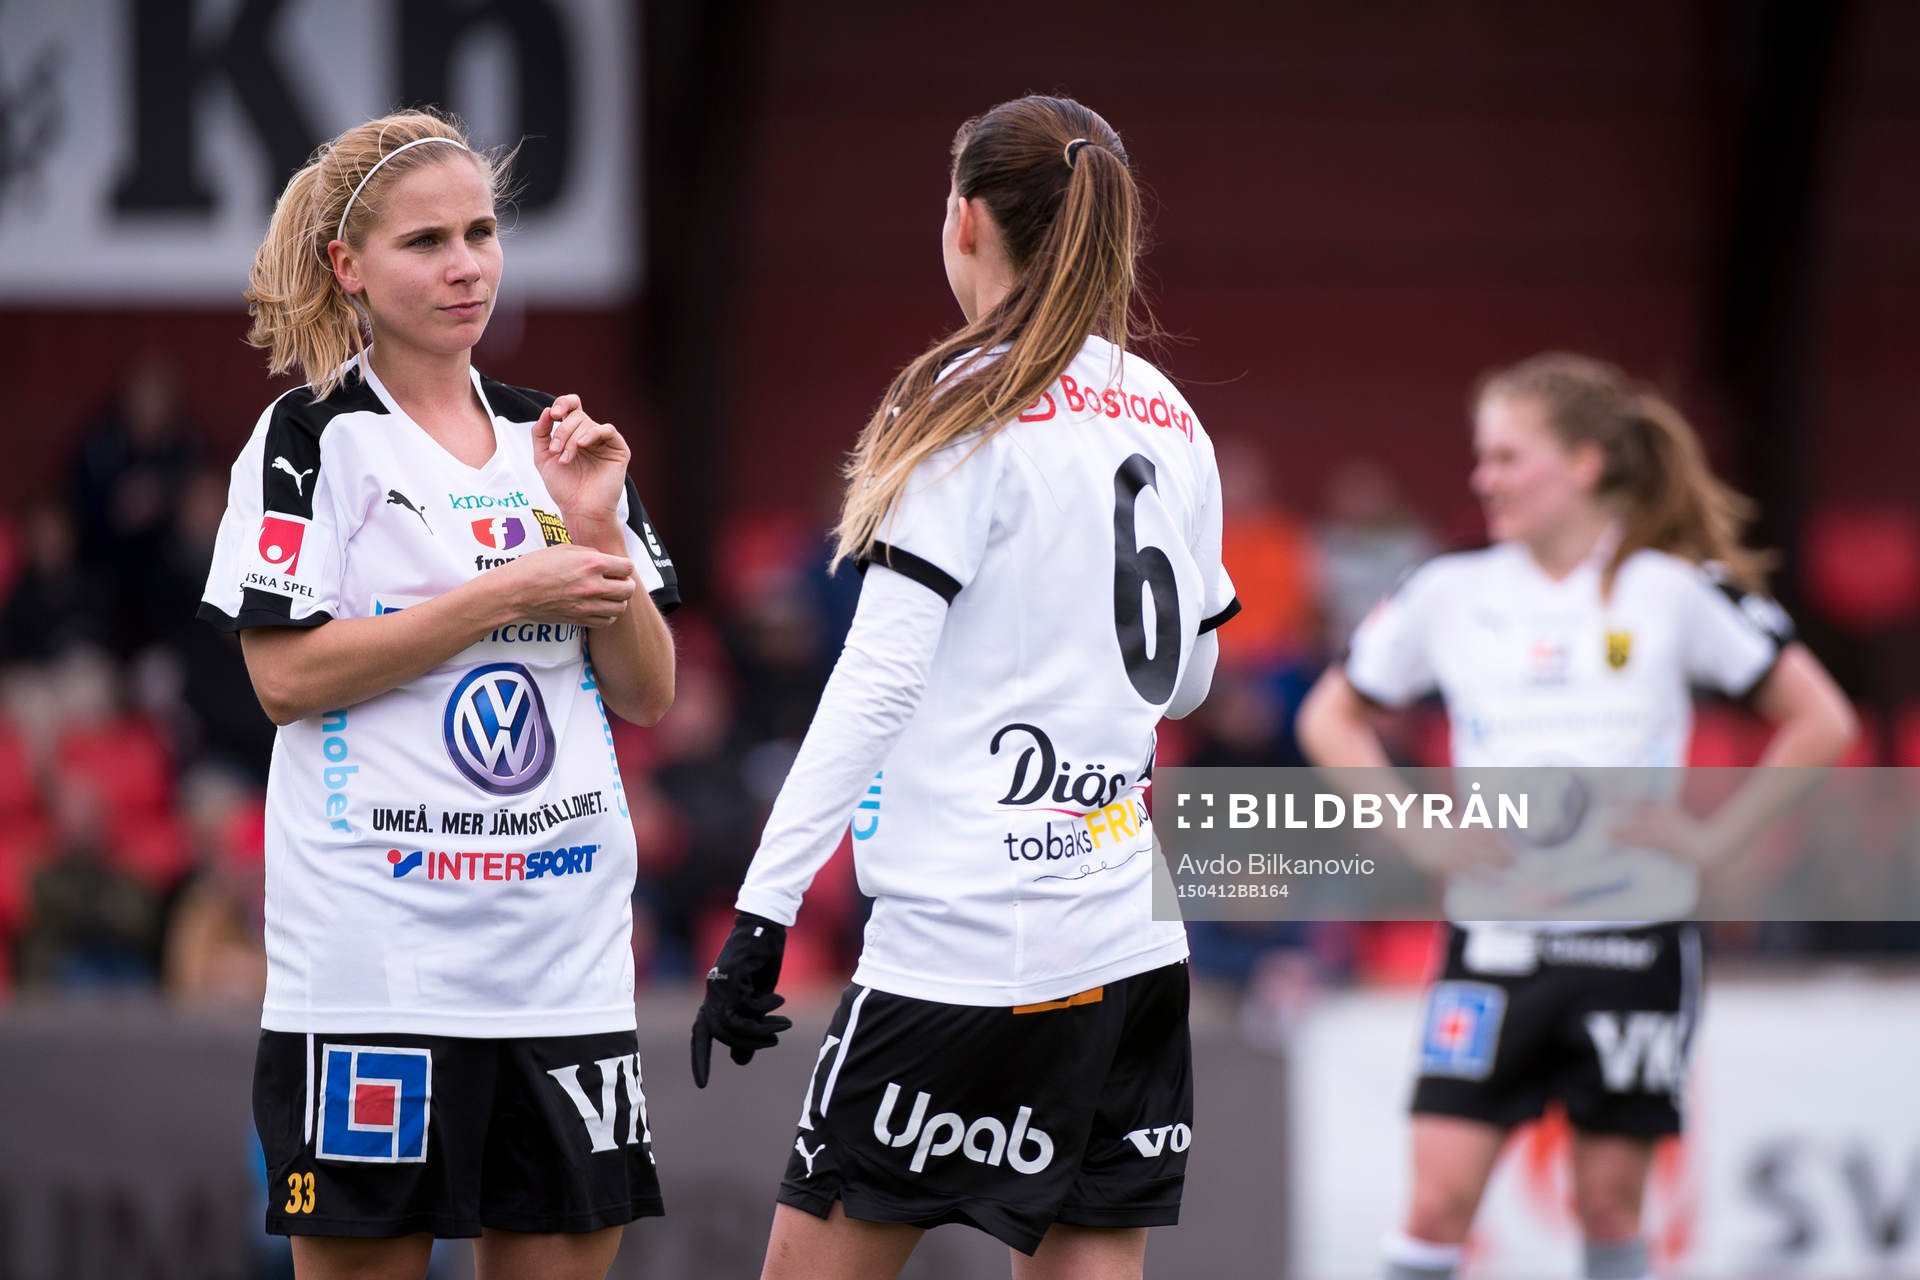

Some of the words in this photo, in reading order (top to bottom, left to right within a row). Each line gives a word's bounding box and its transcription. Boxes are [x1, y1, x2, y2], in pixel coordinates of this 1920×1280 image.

[1060, 374, 1194, 443] Bostaden
[449, 490, 529, 509] knowit
[282, 580, 316, 598] SPEL
[1114, 453, 1182, 706] 6
[372, 803, 434, 833] UMEÅ.
[441, 811, 484, 835] MER
[427, 845, 598, 881] INTERSPORT
[873, 1082, 1055, 1174] Upab
[285, 1171, 316, 1215] 33
